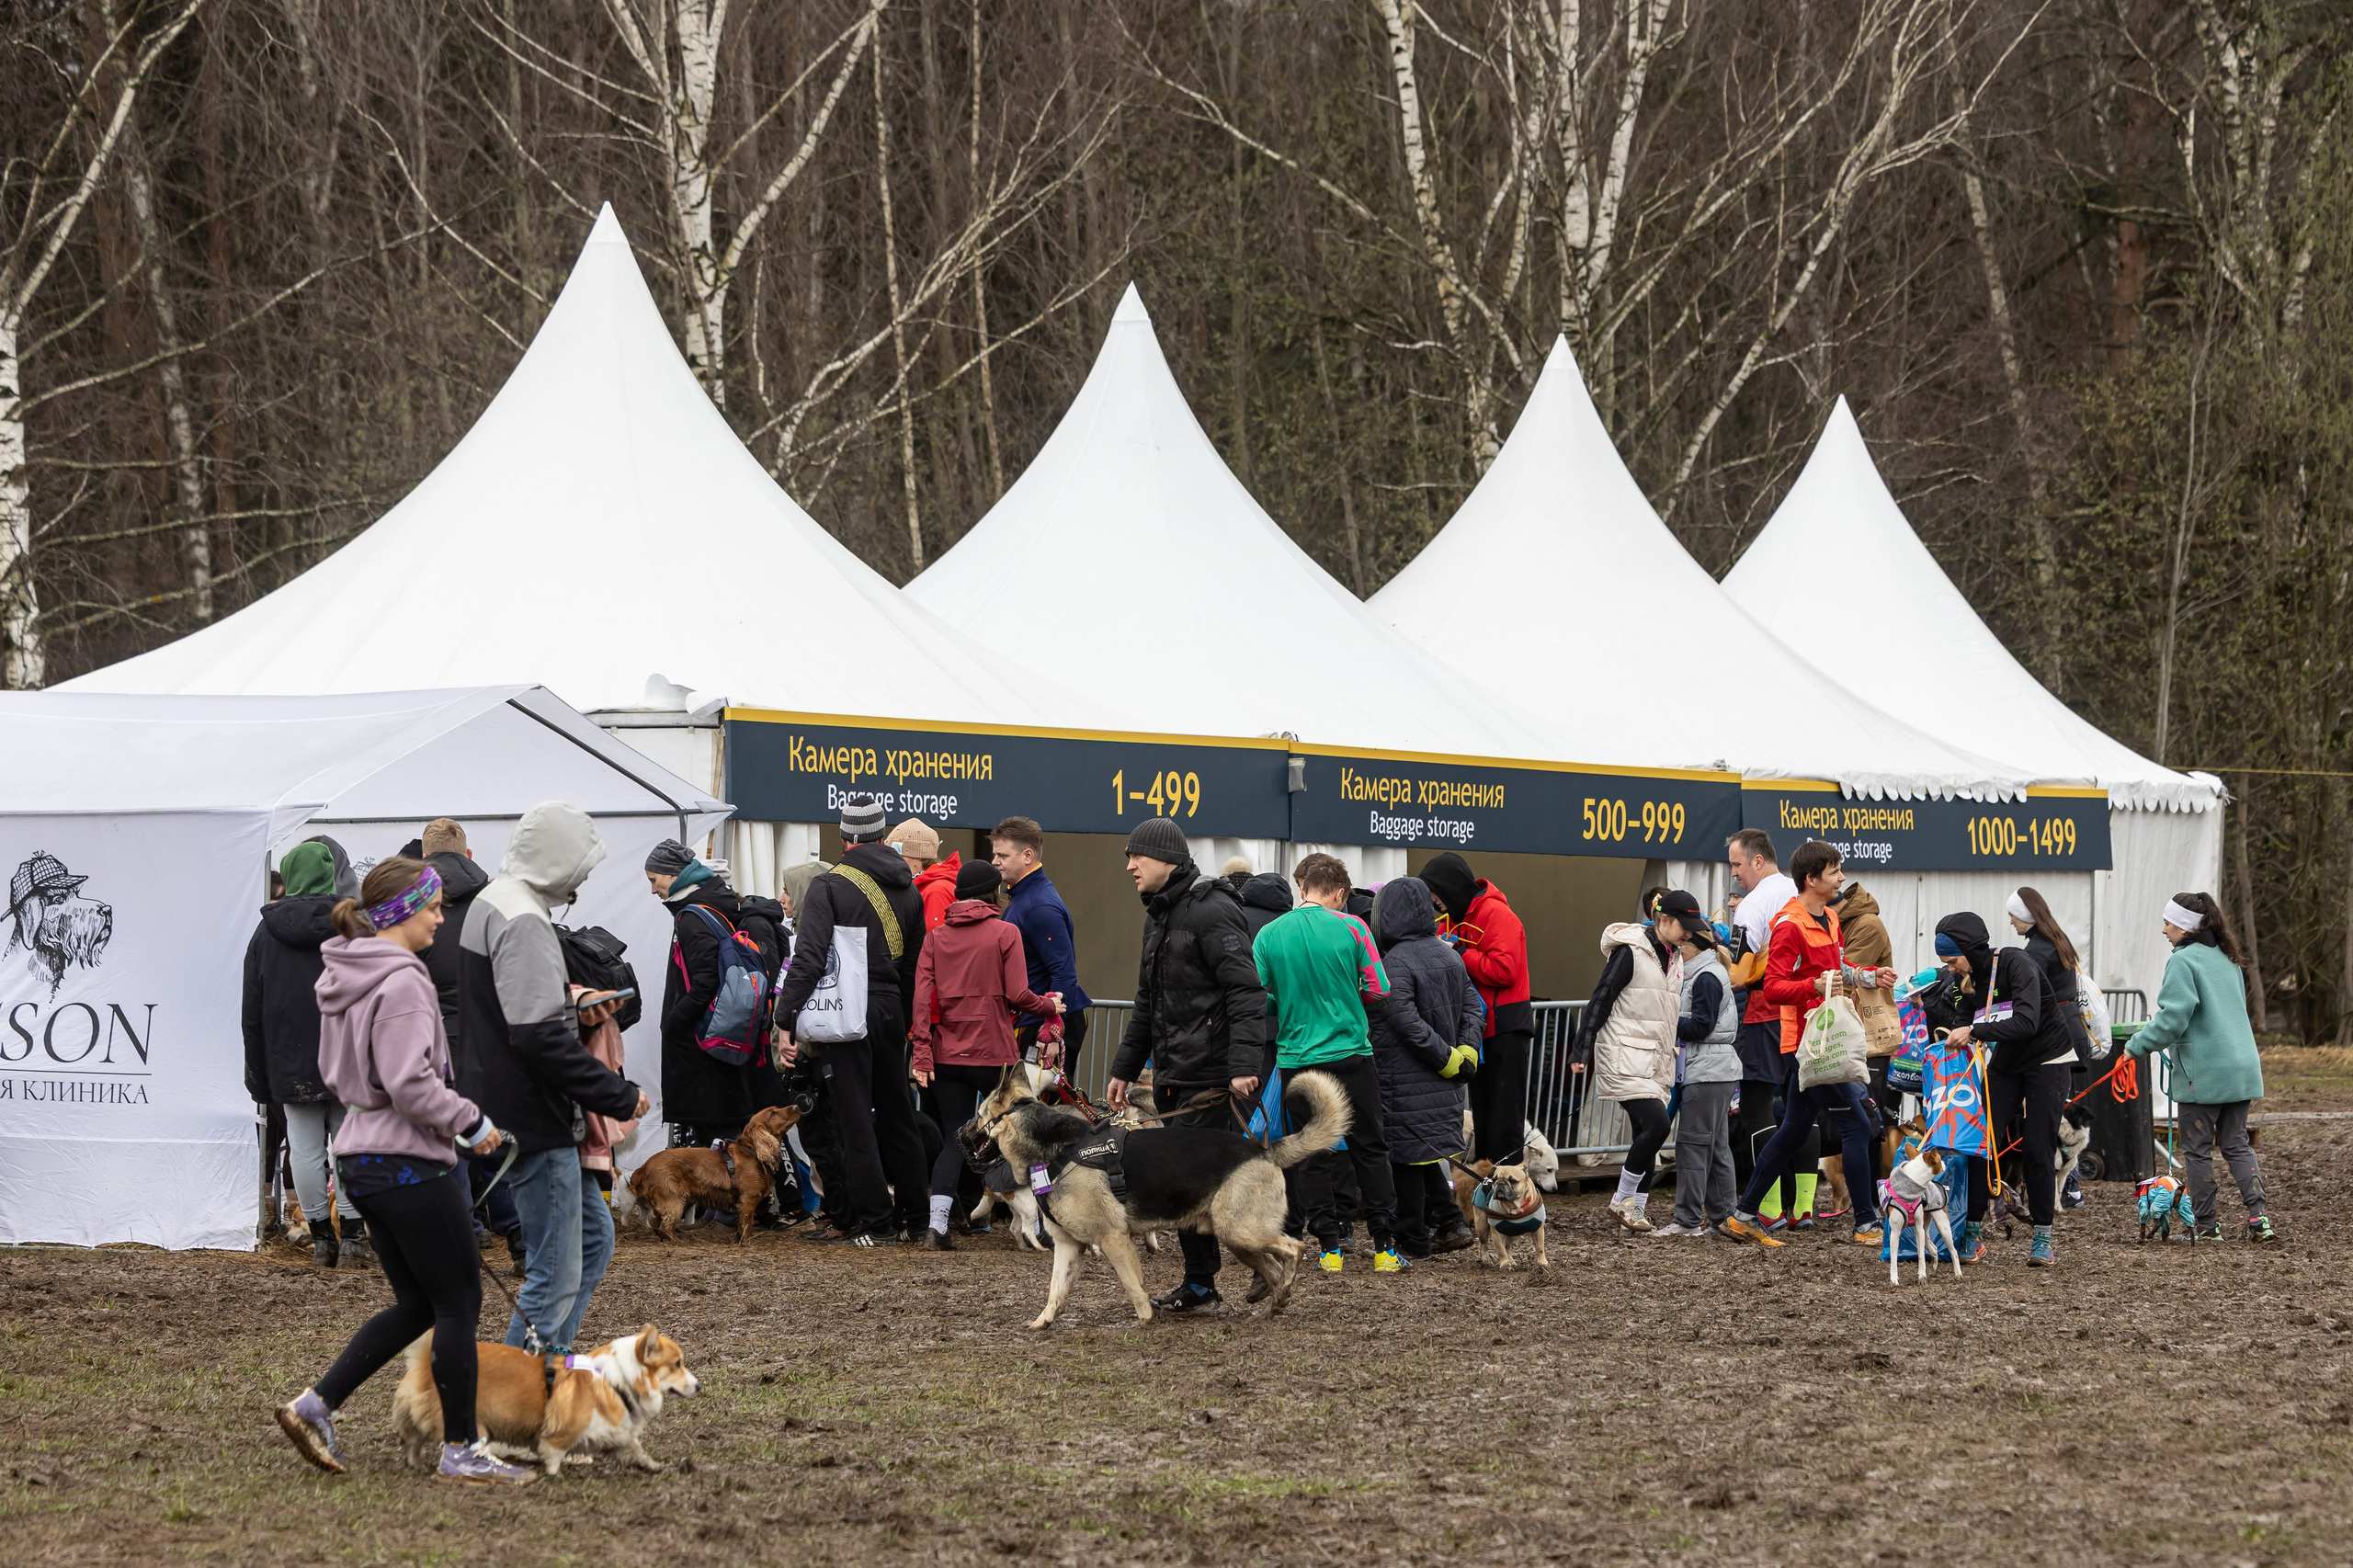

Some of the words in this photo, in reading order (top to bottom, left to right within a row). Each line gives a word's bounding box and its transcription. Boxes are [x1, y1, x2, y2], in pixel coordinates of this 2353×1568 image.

[789, 735, 878, 784] Камера
[885, 749, 993, 786] хранения
[899, 789, 958, 821] storage
[1341, 767, 1412, 811] Камера
[1417, 779, 1505, 812] хранения
[1370, 810, 1424, 841] Baggage
[1427, 815, 1475, 844] storage
[1779, 799, 1839, 836] Камера
[1843, 807, 1915, 837] хранения
[1853, 839, 1893, 864] storage
[0, 1002, 158, 1065] SON
[1902, 1024, 1929, 1044] ZO
[1813, 1061, 1841, 1074] penses
[22, 1080, 149, 1105] КЛИНИКА
